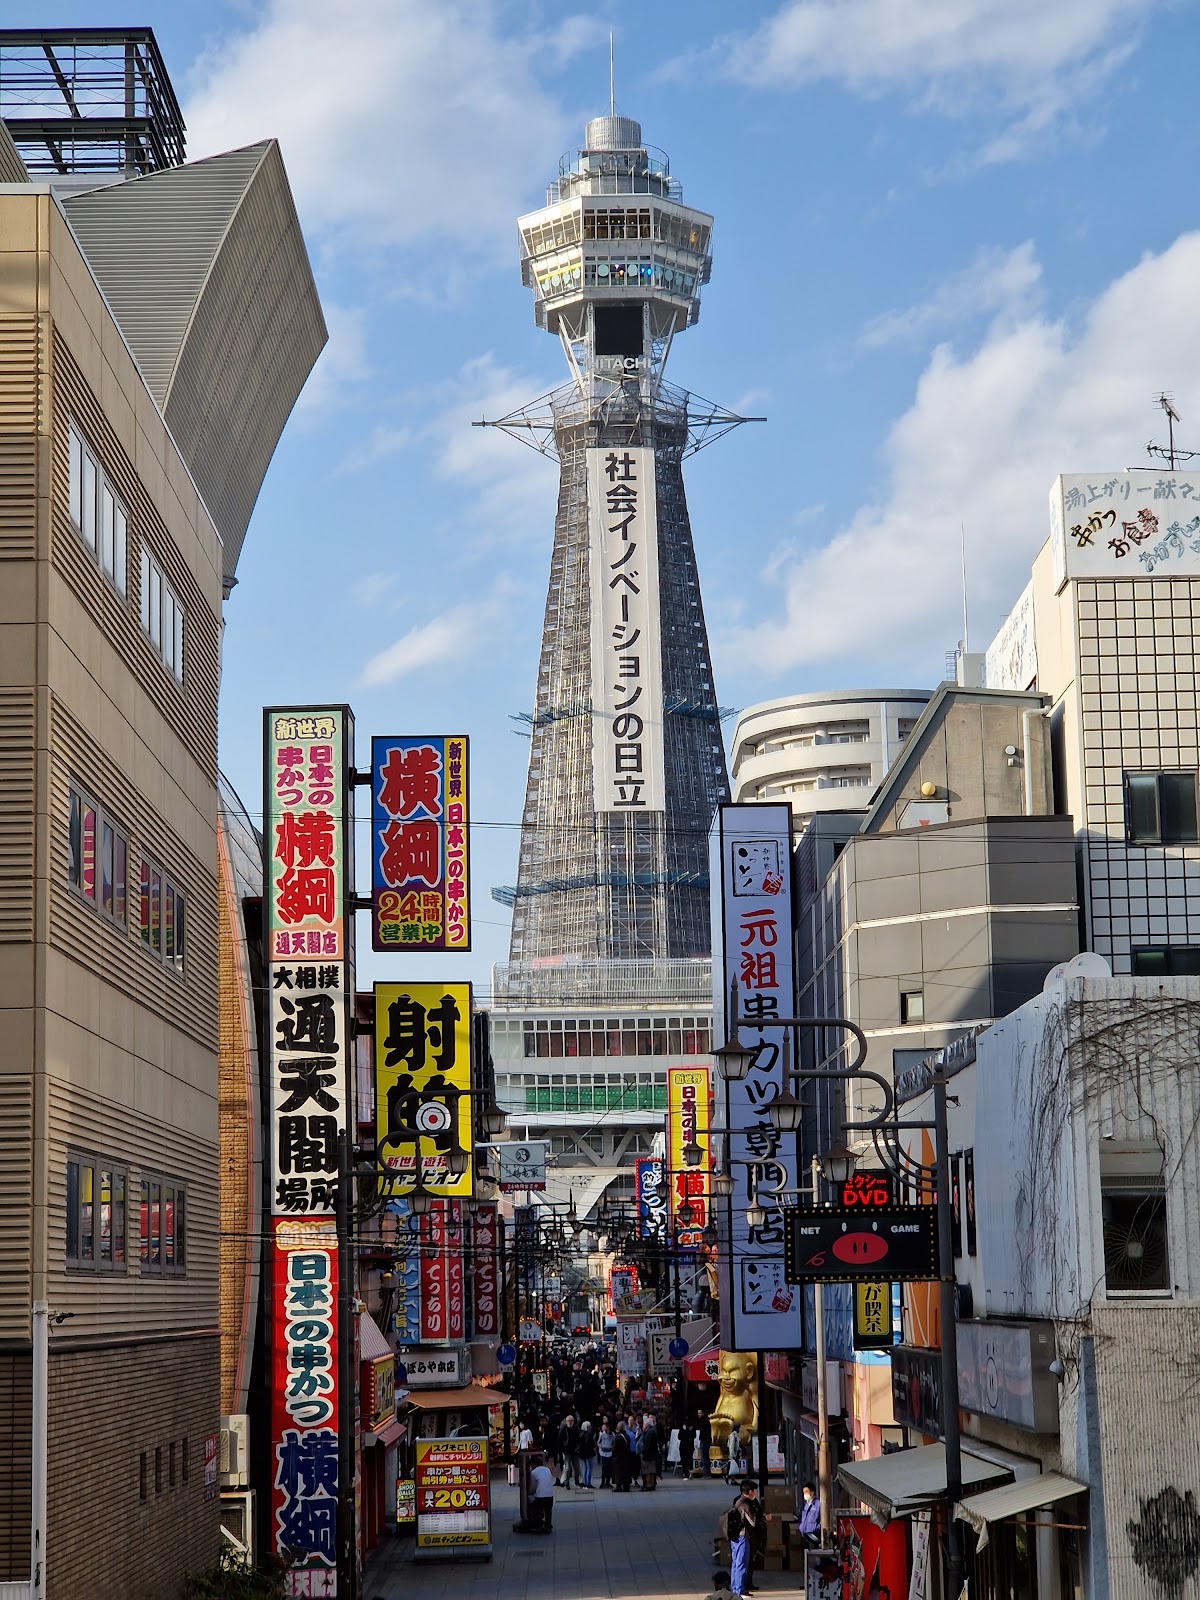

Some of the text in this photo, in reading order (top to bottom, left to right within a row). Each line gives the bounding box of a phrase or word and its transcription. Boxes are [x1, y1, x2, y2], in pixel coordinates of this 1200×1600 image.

[591, 357, 651, 369] HITACHI
[604, 452, 647, 807] 社会イノベーションの日立
[275, 717, 336, 741] 新世界
[277, 746, 305, 806] 串かつ
[307, 745, 335, 807] 日本一の
[448, 742, 462, 798] 新世界
[380, 747, 442, 887] 横綱
[274, 811, 336, 926] 横綱
[446, 803, 465, 943] 日本一の串かつ
[276, 931, 337, 956] 通天閣店
[381, 924, 441, 943] 営業中
[273, 965, 340, 990] 大相撲
[275, 994, 340, 1175] 通天閣
[383, 994, 461, 1150] 射的
[675, 1073, 702, 1084] 新世界
[276, 1177, 338, 1213] 場所
[843, 1189, 889, 1206] DVD
[800, 1227, 821, 1235] NET
[890, 1225, 920, 1233] GAME
[426, 1263, 442, 1333] てっちり
[450, 1263, 461, 1331] てっちり
[864, 1283, 882, 1333] が喫茶
[288, 1253, 331, 1423] 日本一の串かつ
[403, 1360, 456, 1375] ぼらや本店
[275, 1430, 338, 1563] 横綱
[425, 1490, 434, 1508] 最大
